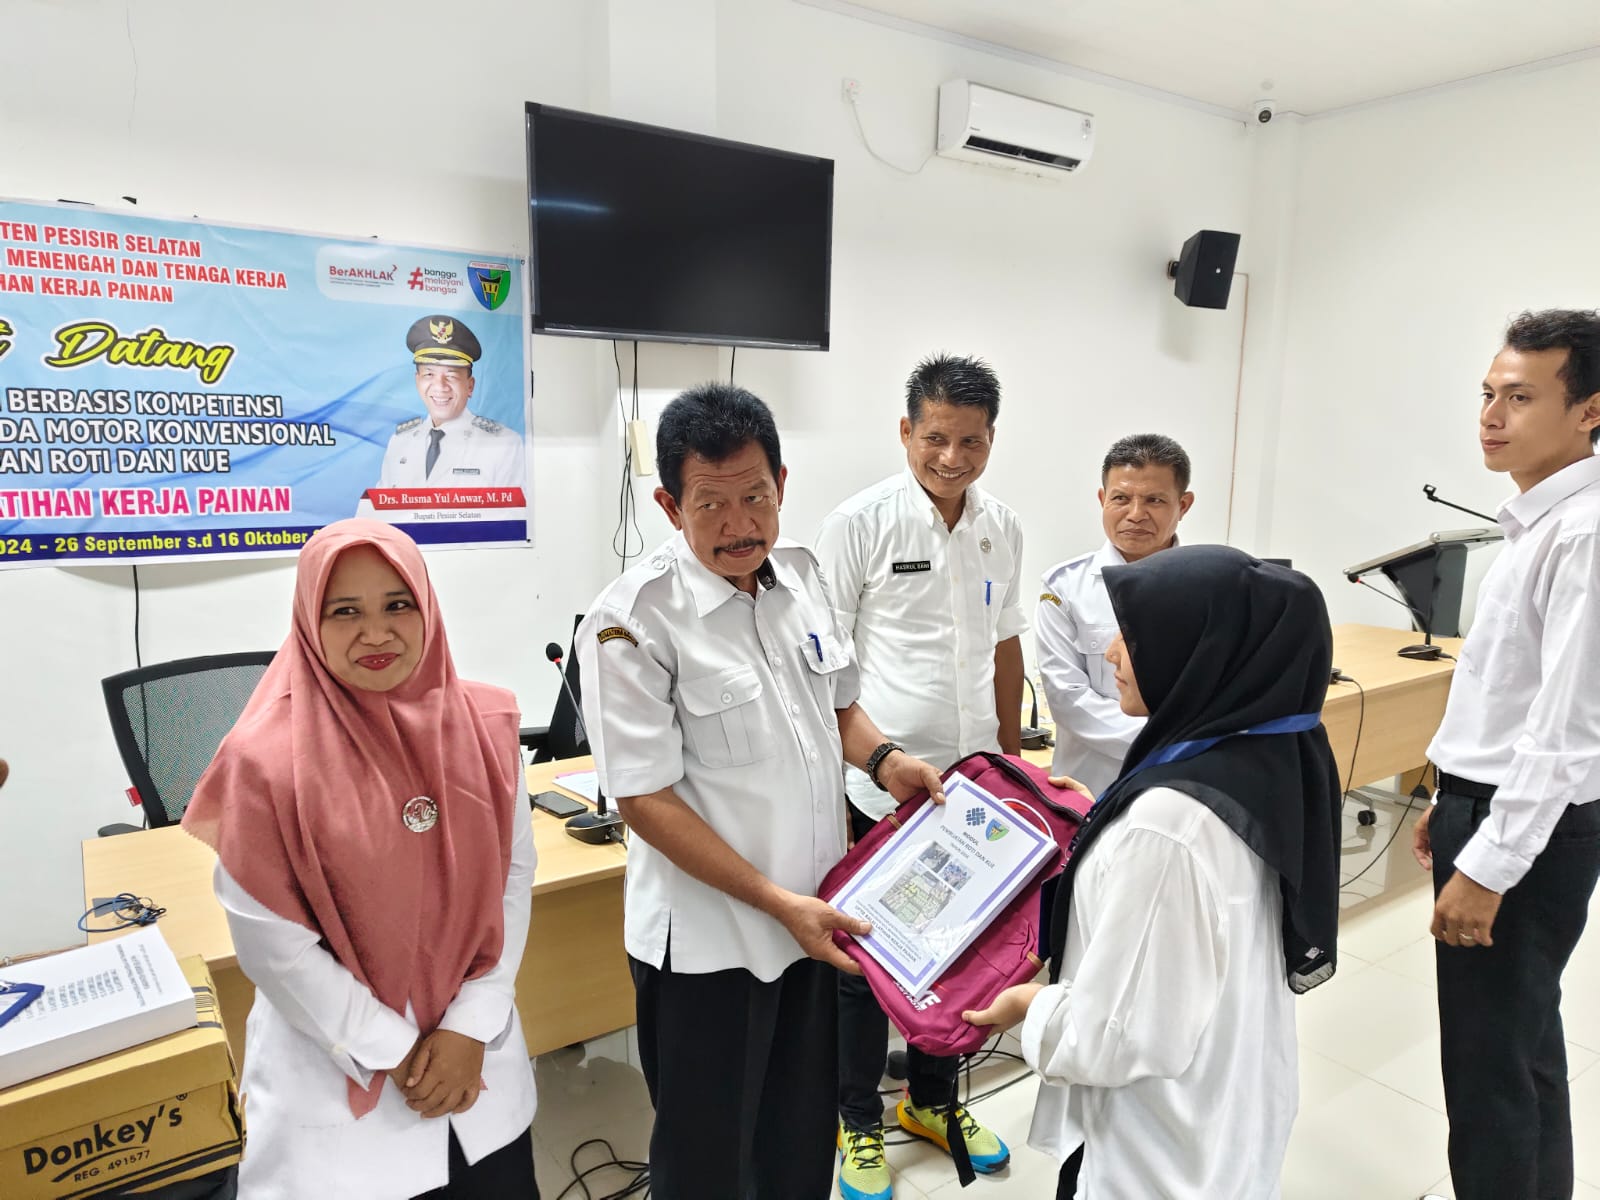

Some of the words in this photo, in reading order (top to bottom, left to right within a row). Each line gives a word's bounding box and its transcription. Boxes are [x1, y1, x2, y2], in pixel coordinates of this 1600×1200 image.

[0, 221, 38, 242] TEN
[43, 226, 119, 250] PESISIR
[125, 234, 201, 258] SELATAN
[6, 247, 116, 274] MENENGAH
[122, 258, 158, 278] DAN
[163, 262, 231, 284] TENAGA
[235, 268, 287, 289] KERJA
[329, 265, 394, 281] BerAKHLAK
[424, 268, 457, 279] bangga
[40, 276, 102, 297] KERJA
[107, 281, 173, 303] PAINAN
[424, 276, 464, 288] melayani
[424, 285, 457, 295] bangsa
[45, 322, 234, 383] Datang
[7, 388, 131, 413] BERBASIS
[136, 391, 283, 417] KOMPETENSI
[0, 417, 41, 443] DA
[44, 418, 144, 444] MOTOR
[147, 419, 336, 445] KONVENSIONAL
[0, 448, 43, 473] AN
[49, 448, 112, 473] ROTI
[117, 448, 176, 473] DAN
[181, 449, 231, 473] KUE
[0, 489, 93, 518] TIHAN
[101, 488, 190, 516] KERJA
[198, 487, 291, 514] PAINAN
[378, 493, 399, 505] Drs.
[401, 492, 432, 504] Rusma
[433, 492, 450, 504] Yul
[452, 492, 485, 505] Anwar,
[487, 491, 499, 503] M.
[501, 492, 513, 503] Pd
[458, 511, 482, 519] Selatan
[54, 537, 80, 553] 26
[84, 534, 182, 554] September
[187, 533, 213, 549] s.d
[218, 532, 240, 547] 16
[244, 530, 308, 547] Oktober
[975, 851, 986, 861] DAN
[23, 1104, 183, 1175] Donkey's
[108, 1149, 151, 1171] 491577
